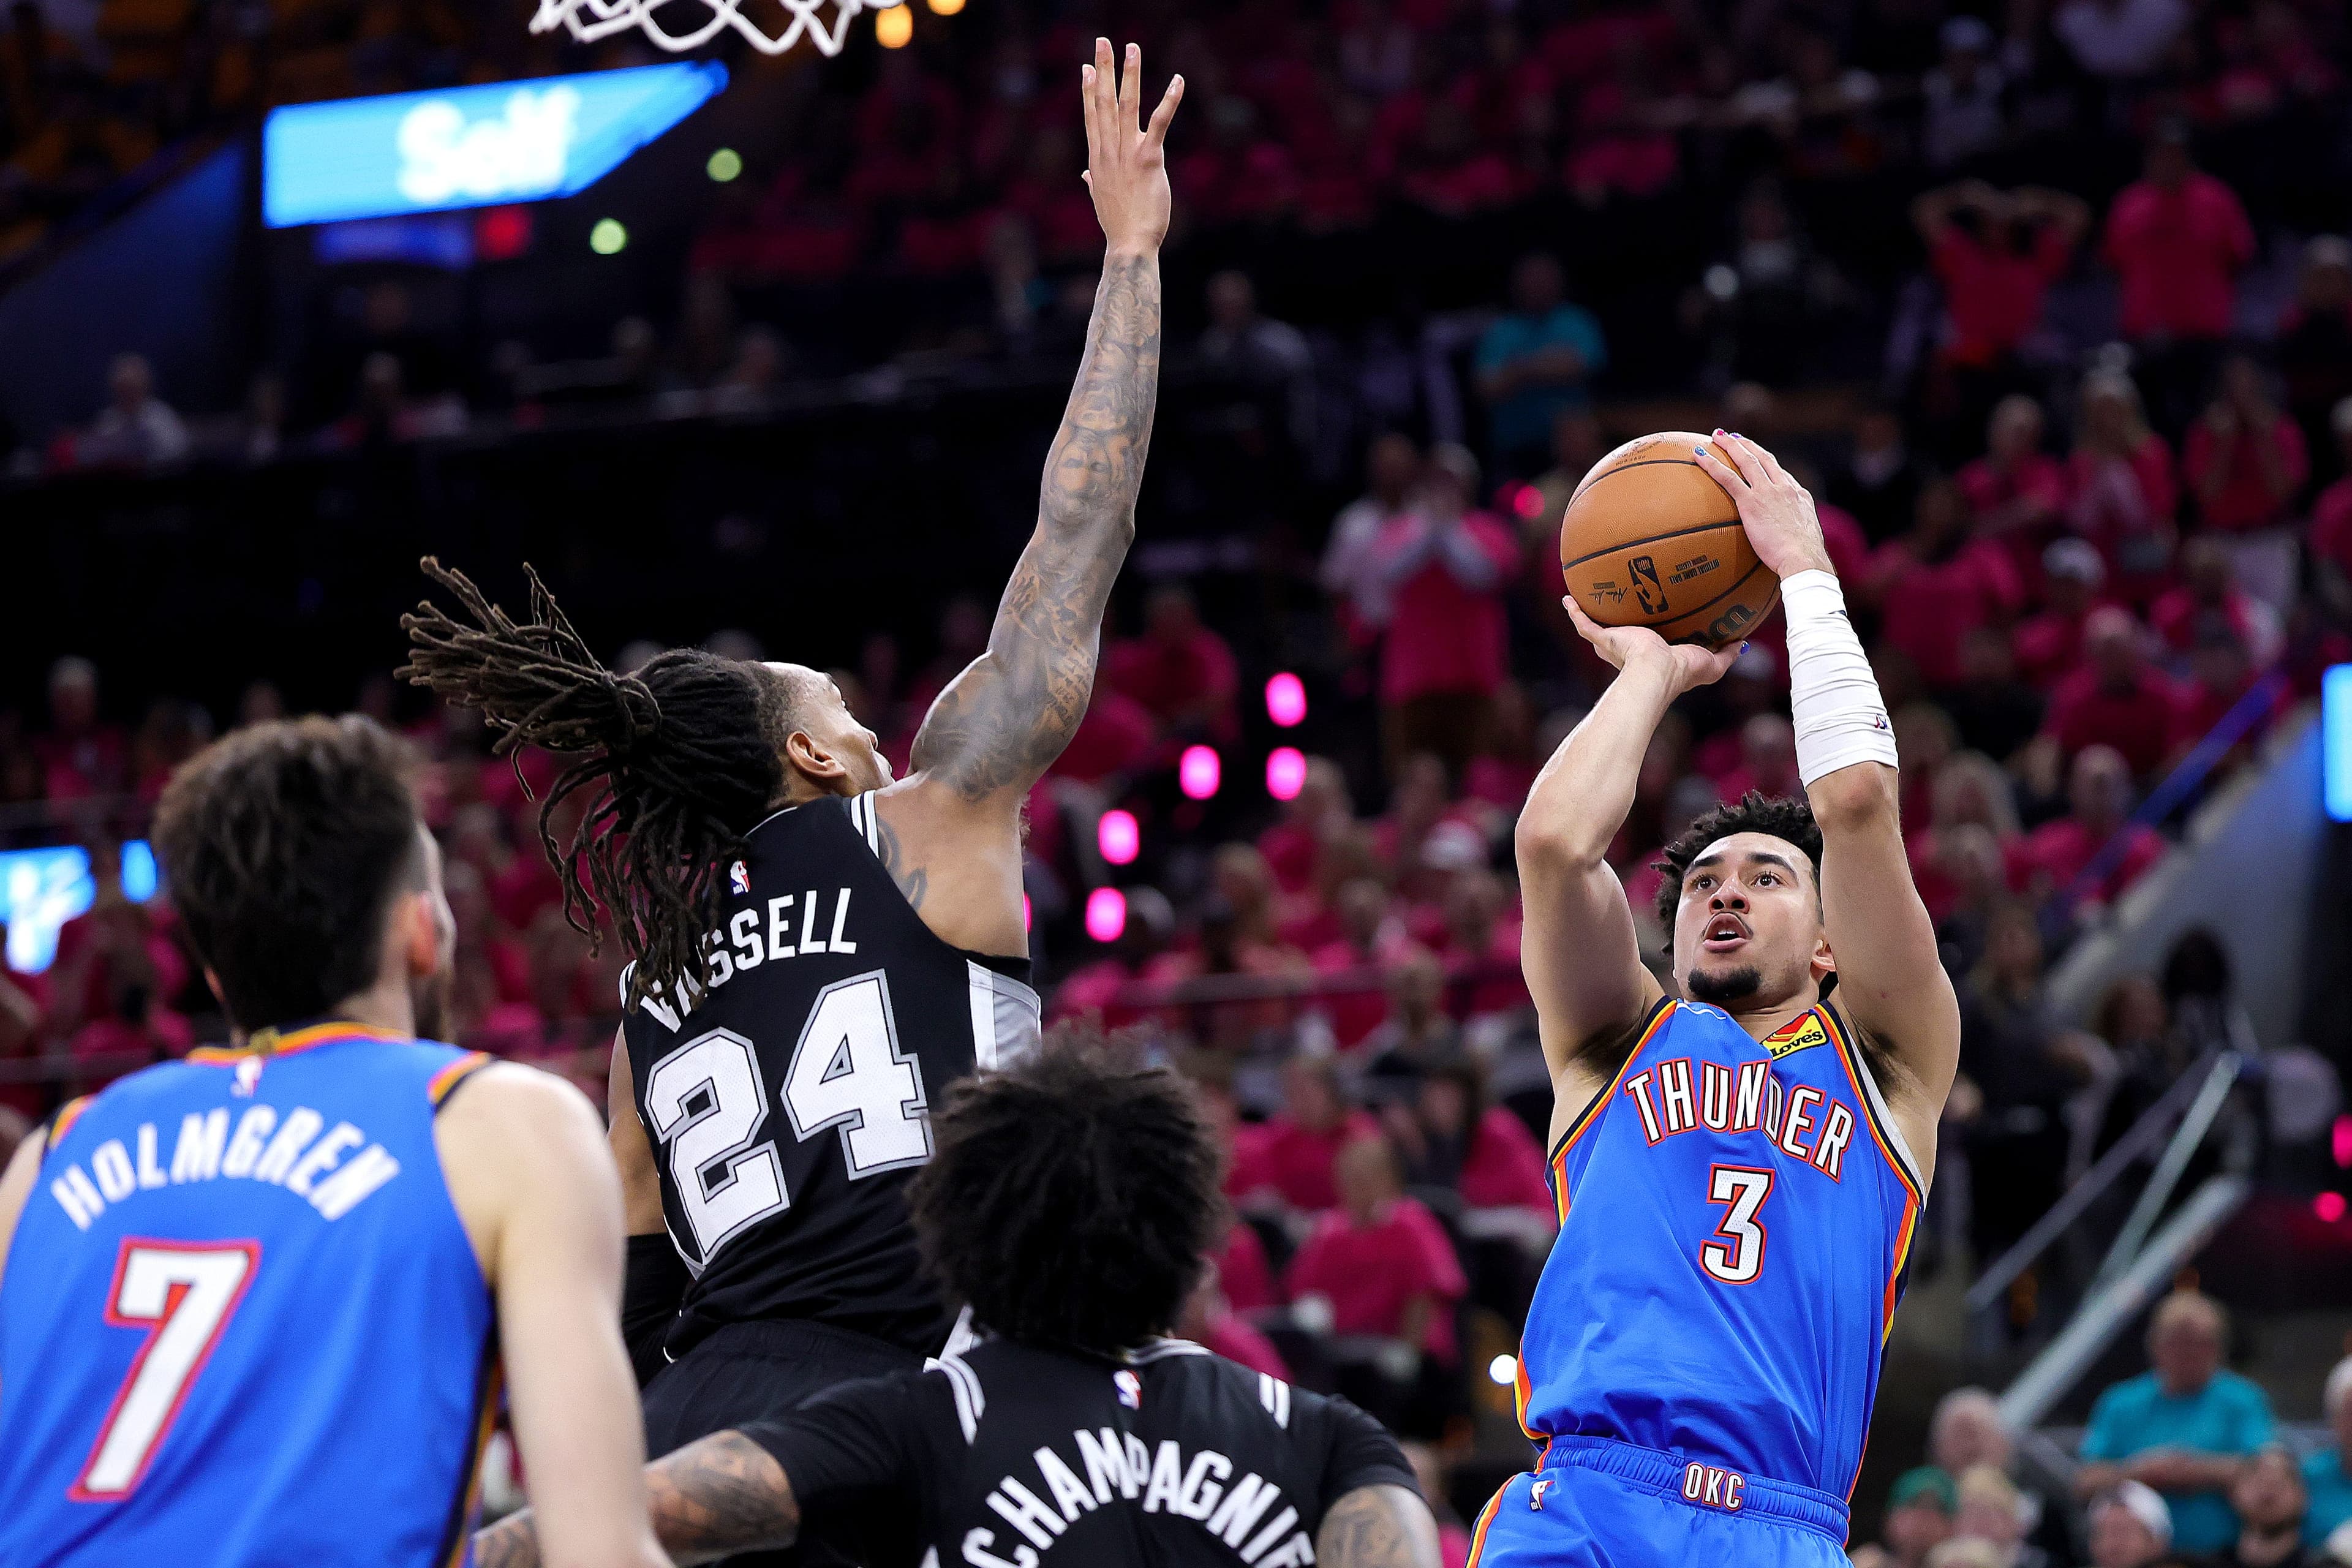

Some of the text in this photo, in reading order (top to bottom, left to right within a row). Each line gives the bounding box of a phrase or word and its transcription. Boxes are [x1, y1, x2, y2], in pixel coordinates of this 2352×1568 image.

[51, 1104, 401, 1231] HOLMGREN
[644, 968, 936, 1265] 24
[1624, 1058, 1855, 1183] THUNDER
[1698, 1163, 1775, 1285] 3
[67, 1237, 263, 1502] 7
[1683, 1462, 1745, 1510] OKC
